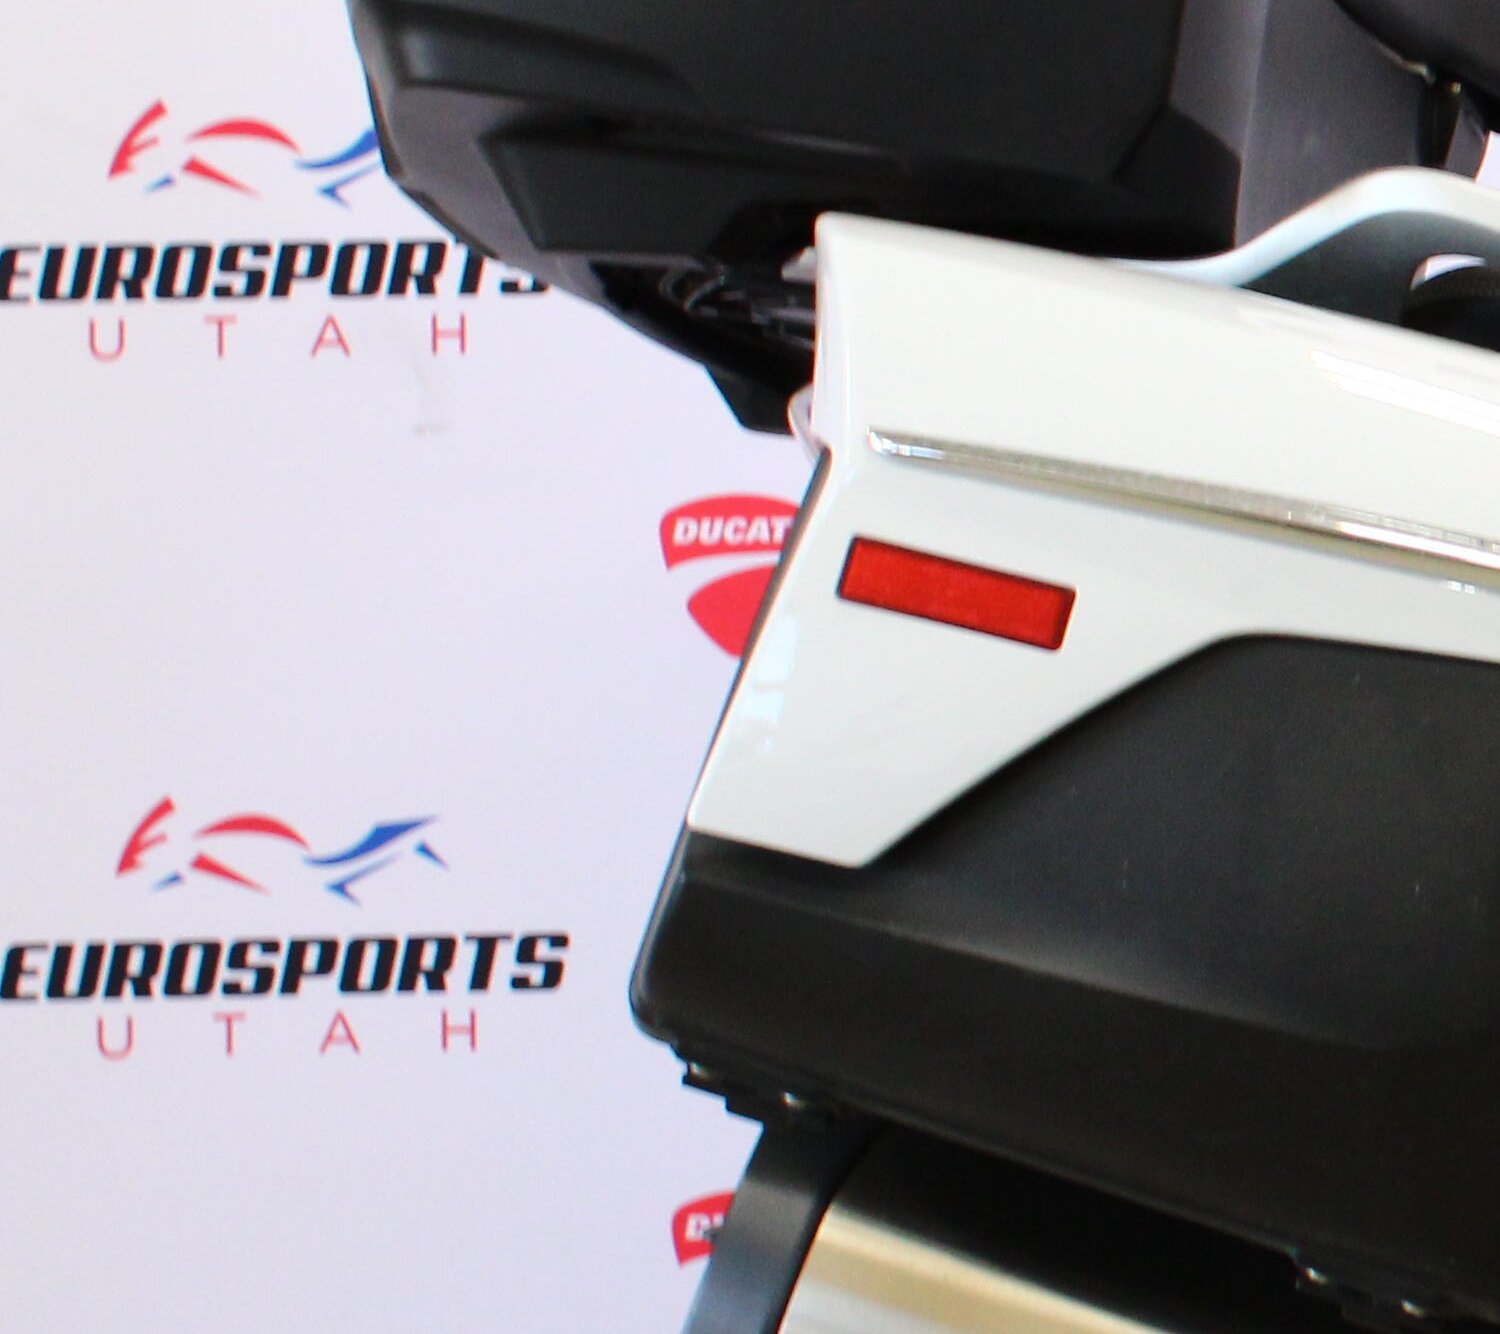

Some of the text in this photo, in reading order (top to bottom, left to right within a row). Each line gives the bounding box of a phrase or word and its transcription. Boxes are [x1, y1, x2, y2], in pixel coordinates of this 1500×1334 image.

[87, 313, 469, 364] UTAH
[671, 514, 796, 547] DUCAT
[0, 931, 570, 1003] EUROSPORTS
[96, 1008, 479, 1062] UTAH
